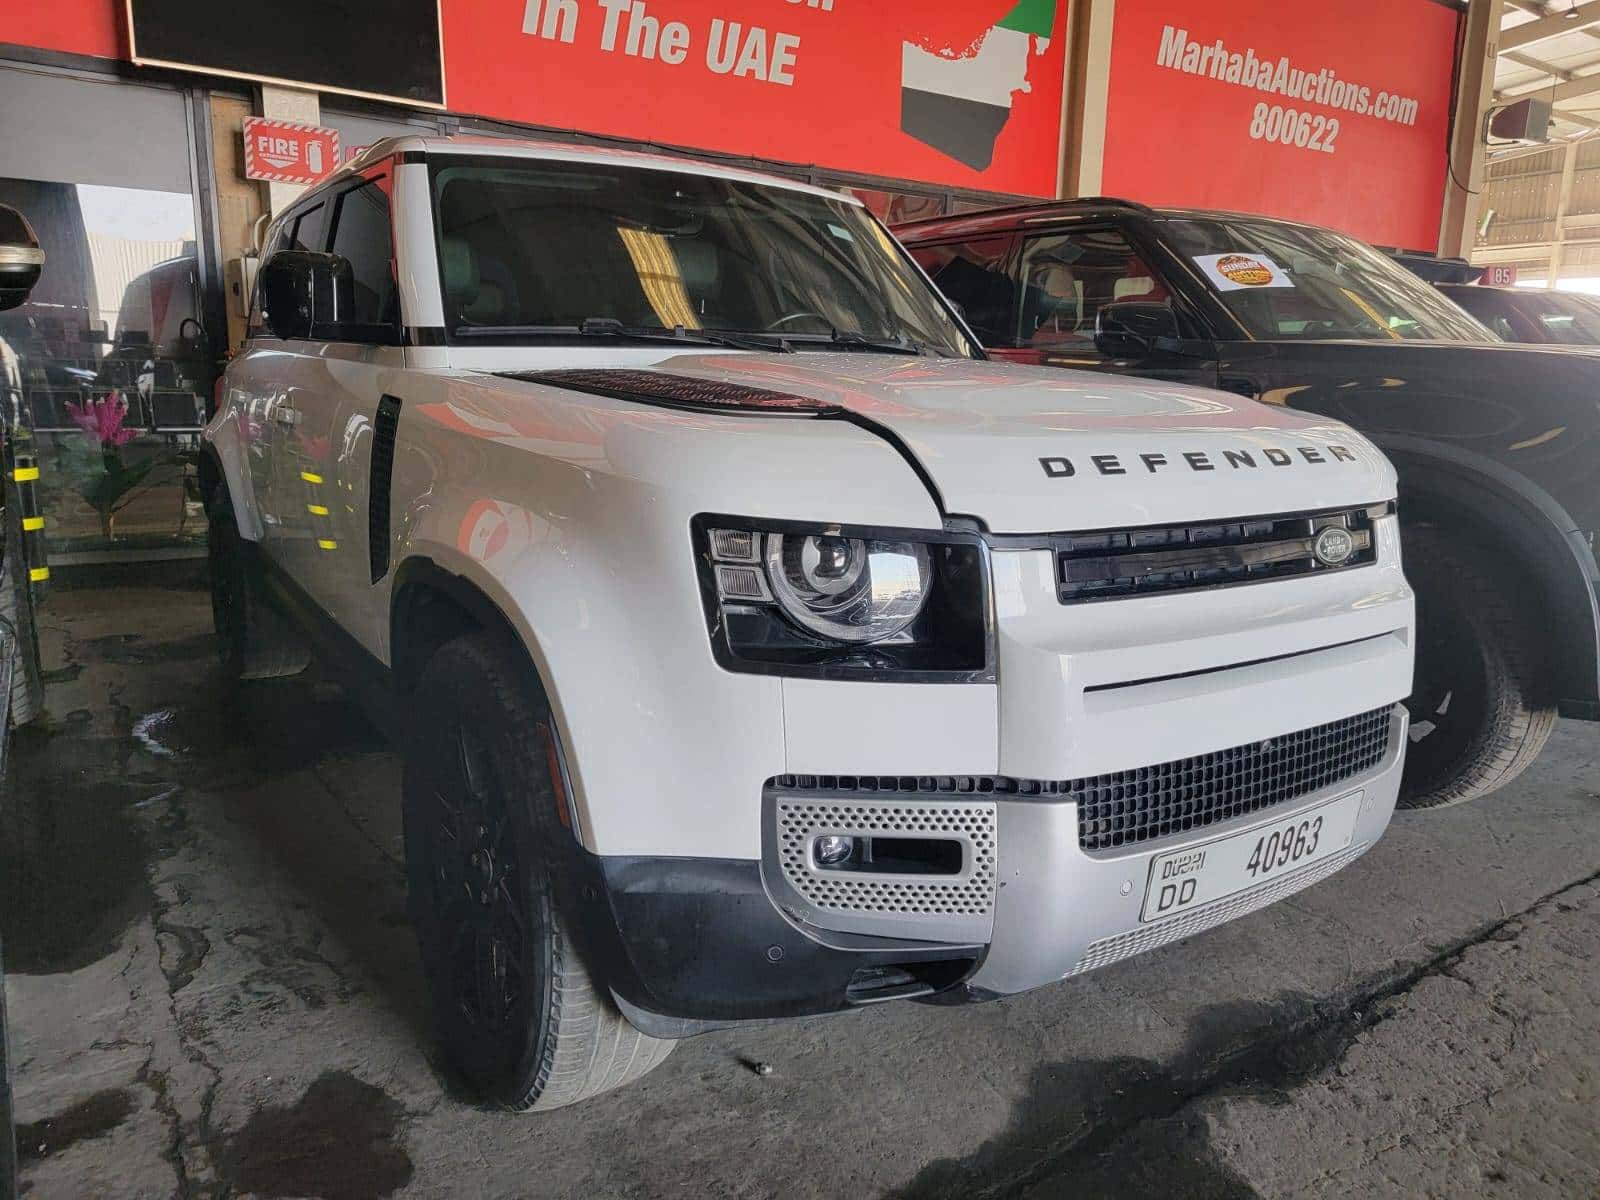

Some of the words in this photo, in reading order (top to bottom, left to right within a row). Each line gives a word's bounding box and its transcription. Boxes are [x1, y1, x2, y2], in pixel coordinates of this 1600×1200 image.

[522, 0, 579, 44] In
[598, 0, 690, 65] The
[705, 18, 801, 86] UAE
[1156, 25, 1419, 127] MarhabaAuctions.com
[257, 136, 300, 157] FIRE
[1249, 102, 1341, 153] 800622
[1038, 445, 1357, 478] DEFENDER
[1246, 815, 1324, 878] 40963
[1158, 877, 1198, 912] DD
